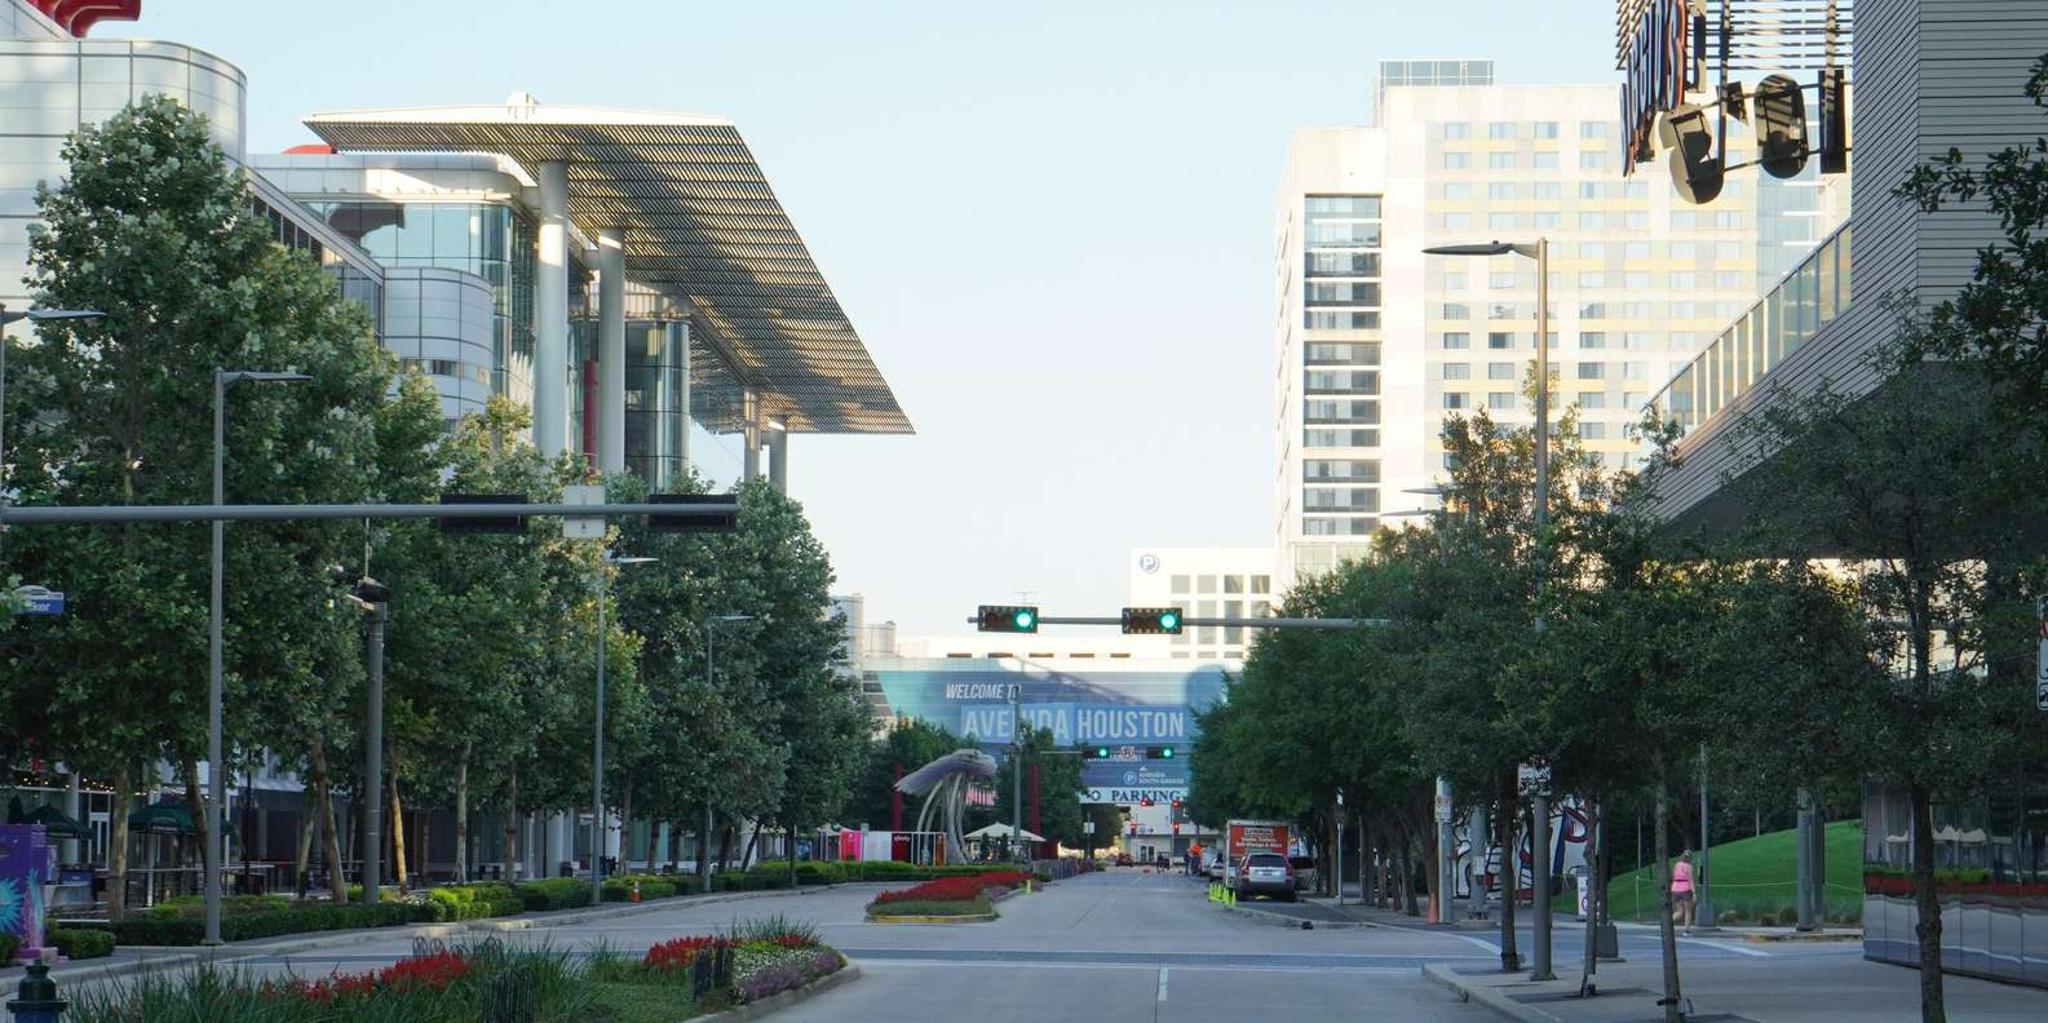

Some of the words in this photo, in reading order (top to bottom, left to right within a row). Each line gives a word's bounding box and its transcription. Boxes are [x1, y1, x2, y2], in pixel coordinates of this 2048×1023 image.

[945, 683, 1004, 700] WELCOME
[1078, 709, 1184, 739] HOUSTON
[1111, 790, 1181, 802] PARKING
